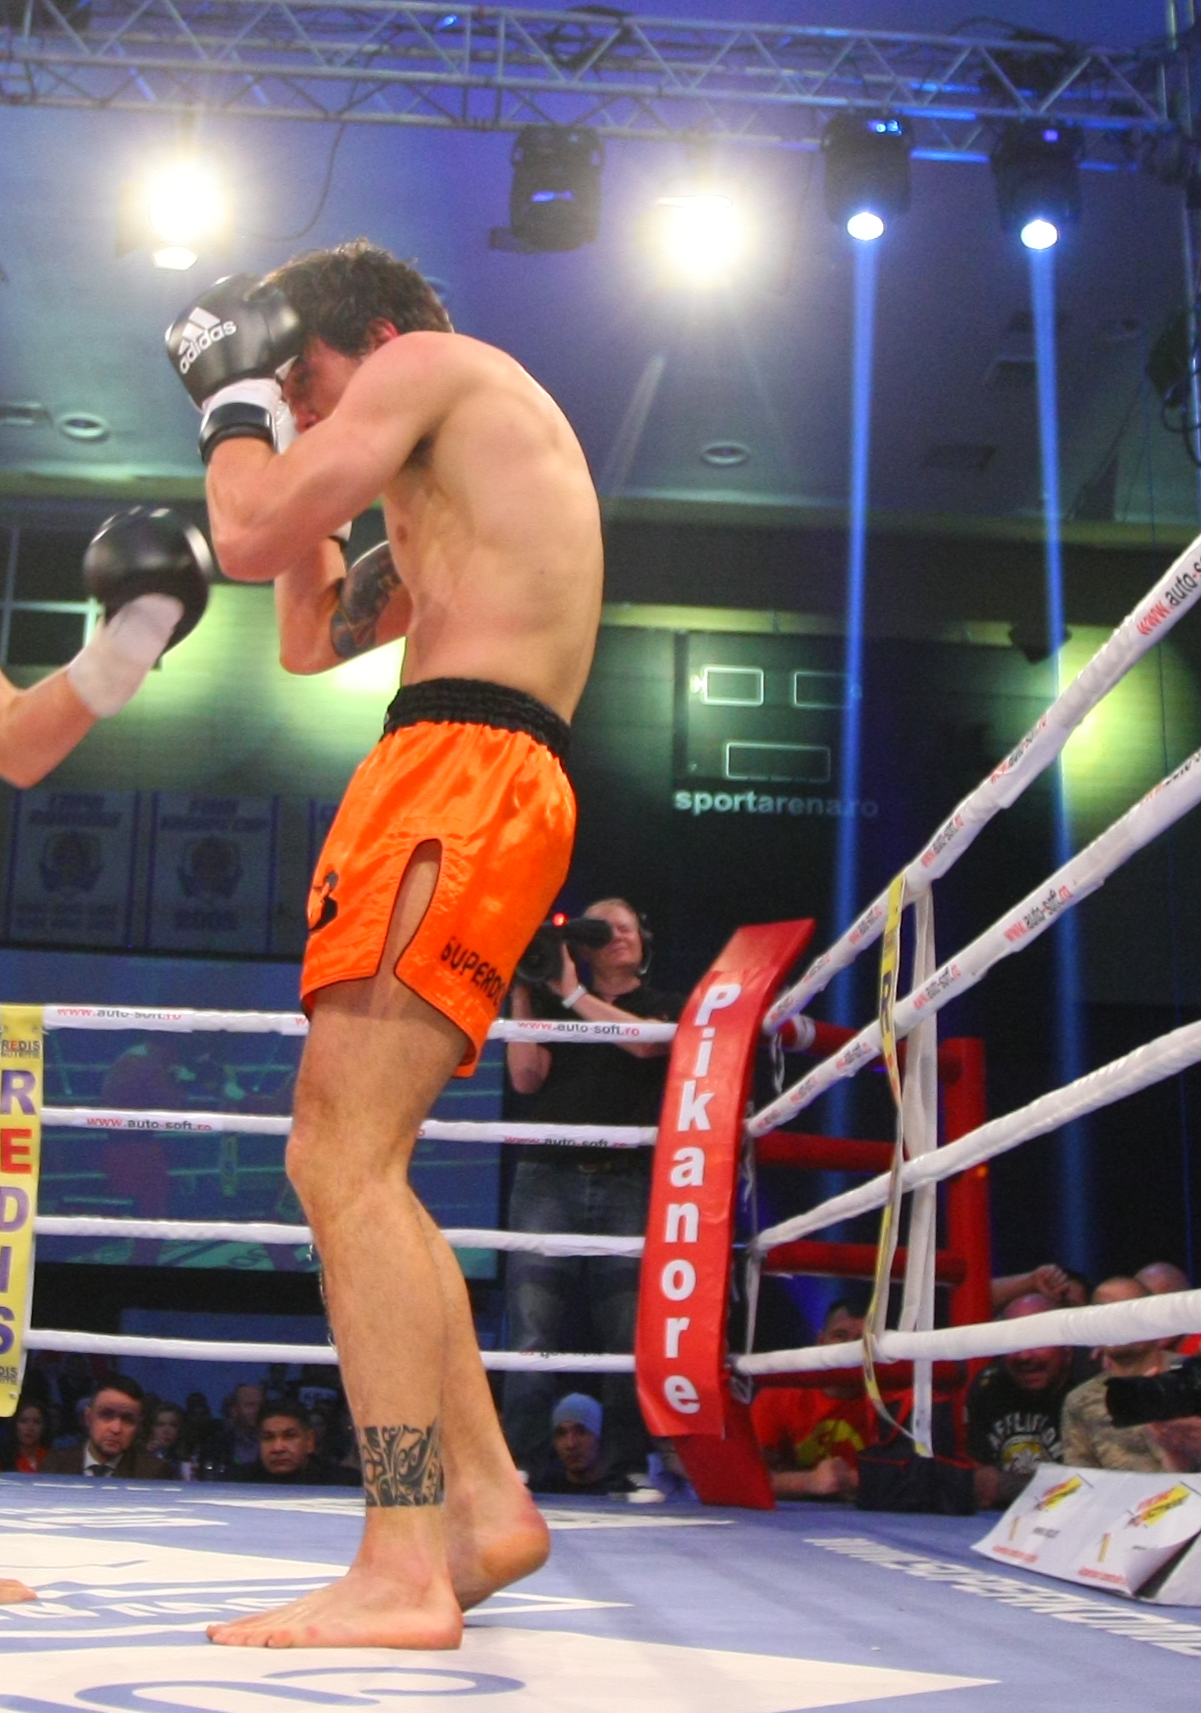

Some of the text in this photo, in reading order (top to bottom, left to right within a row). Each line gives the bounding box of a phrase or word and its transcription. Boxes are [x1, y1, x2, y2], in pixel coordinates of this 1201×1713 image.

[179, 319, 237, 375] adidas
[517, 1021, 640, 1037] www.auto-soft.ro
[1, 1040, 40, 1050] REDIS
[86, 1116, 212, 1131] www.auto-soft.ro
